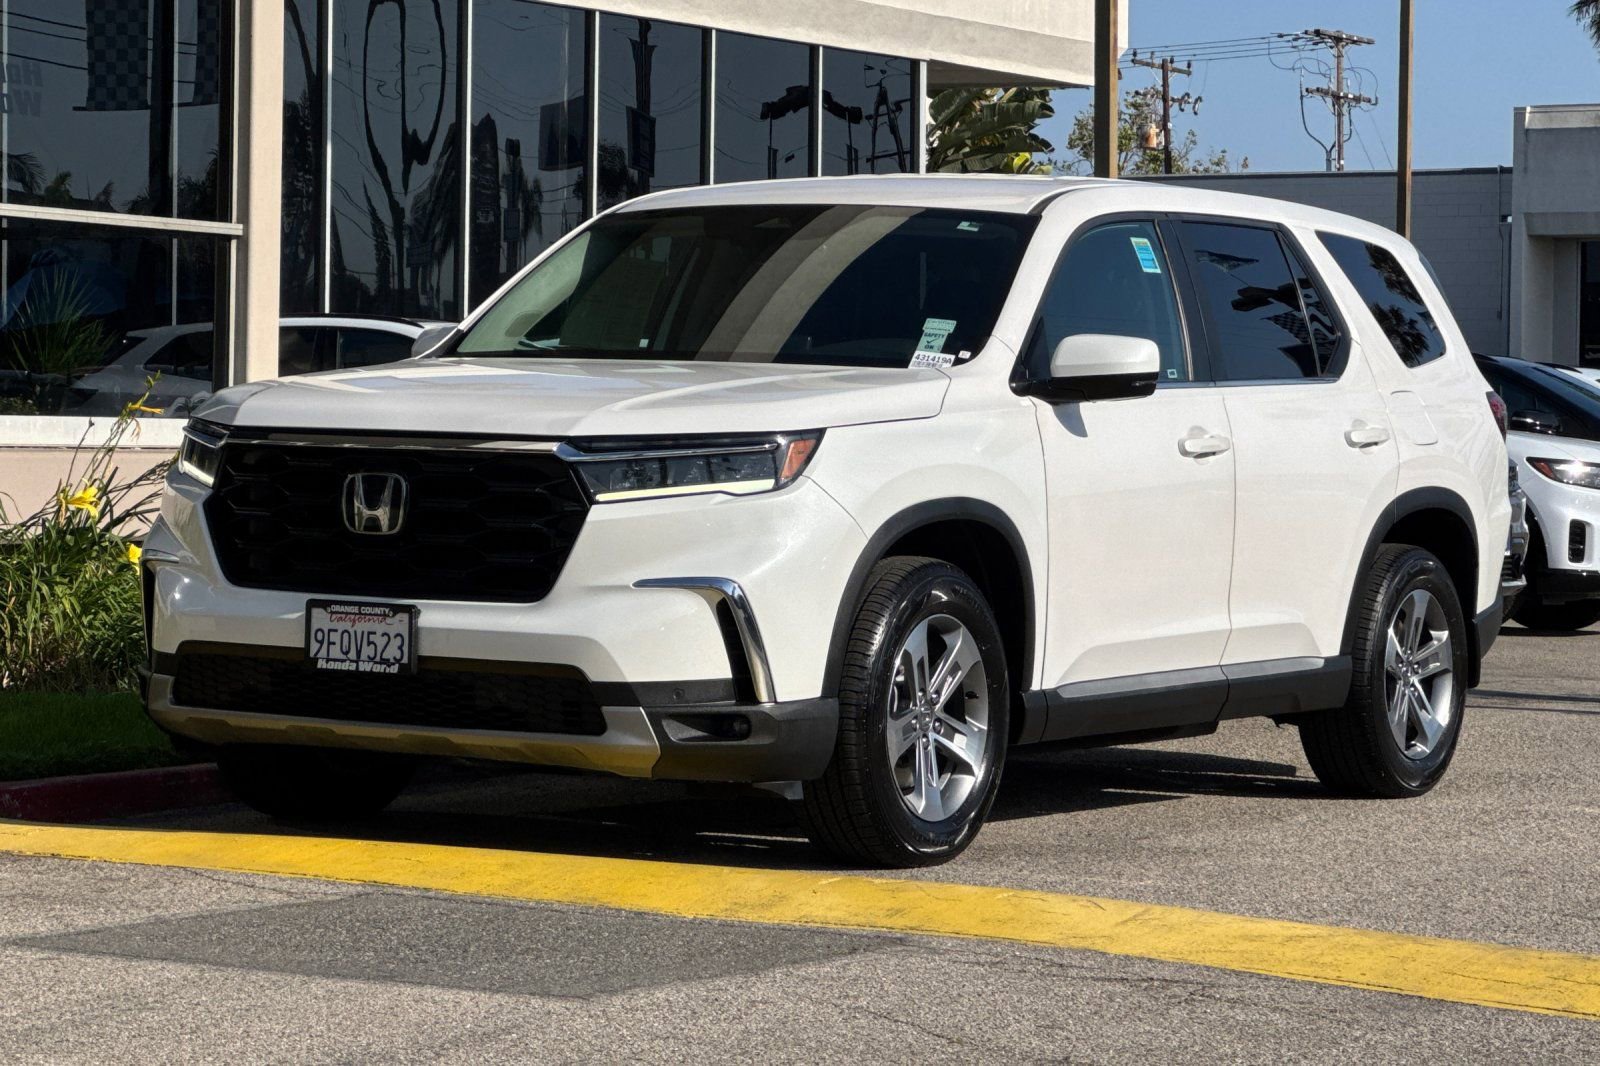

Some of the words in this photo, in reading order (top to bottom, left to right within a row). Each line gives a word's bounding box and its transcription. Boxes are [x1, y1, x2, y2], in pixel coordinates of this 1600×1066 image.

[915, 353, 952, 364] 431419A
[331, 604, 359, 614] ORANGE
[360, 606, 390, 616] COUNTY
[330, 613, 393, 628] California
[314, 628, 404, 663] 9FQV523
[317, 658, 357, 670] Honda
[358, 660, 399, 673] World
